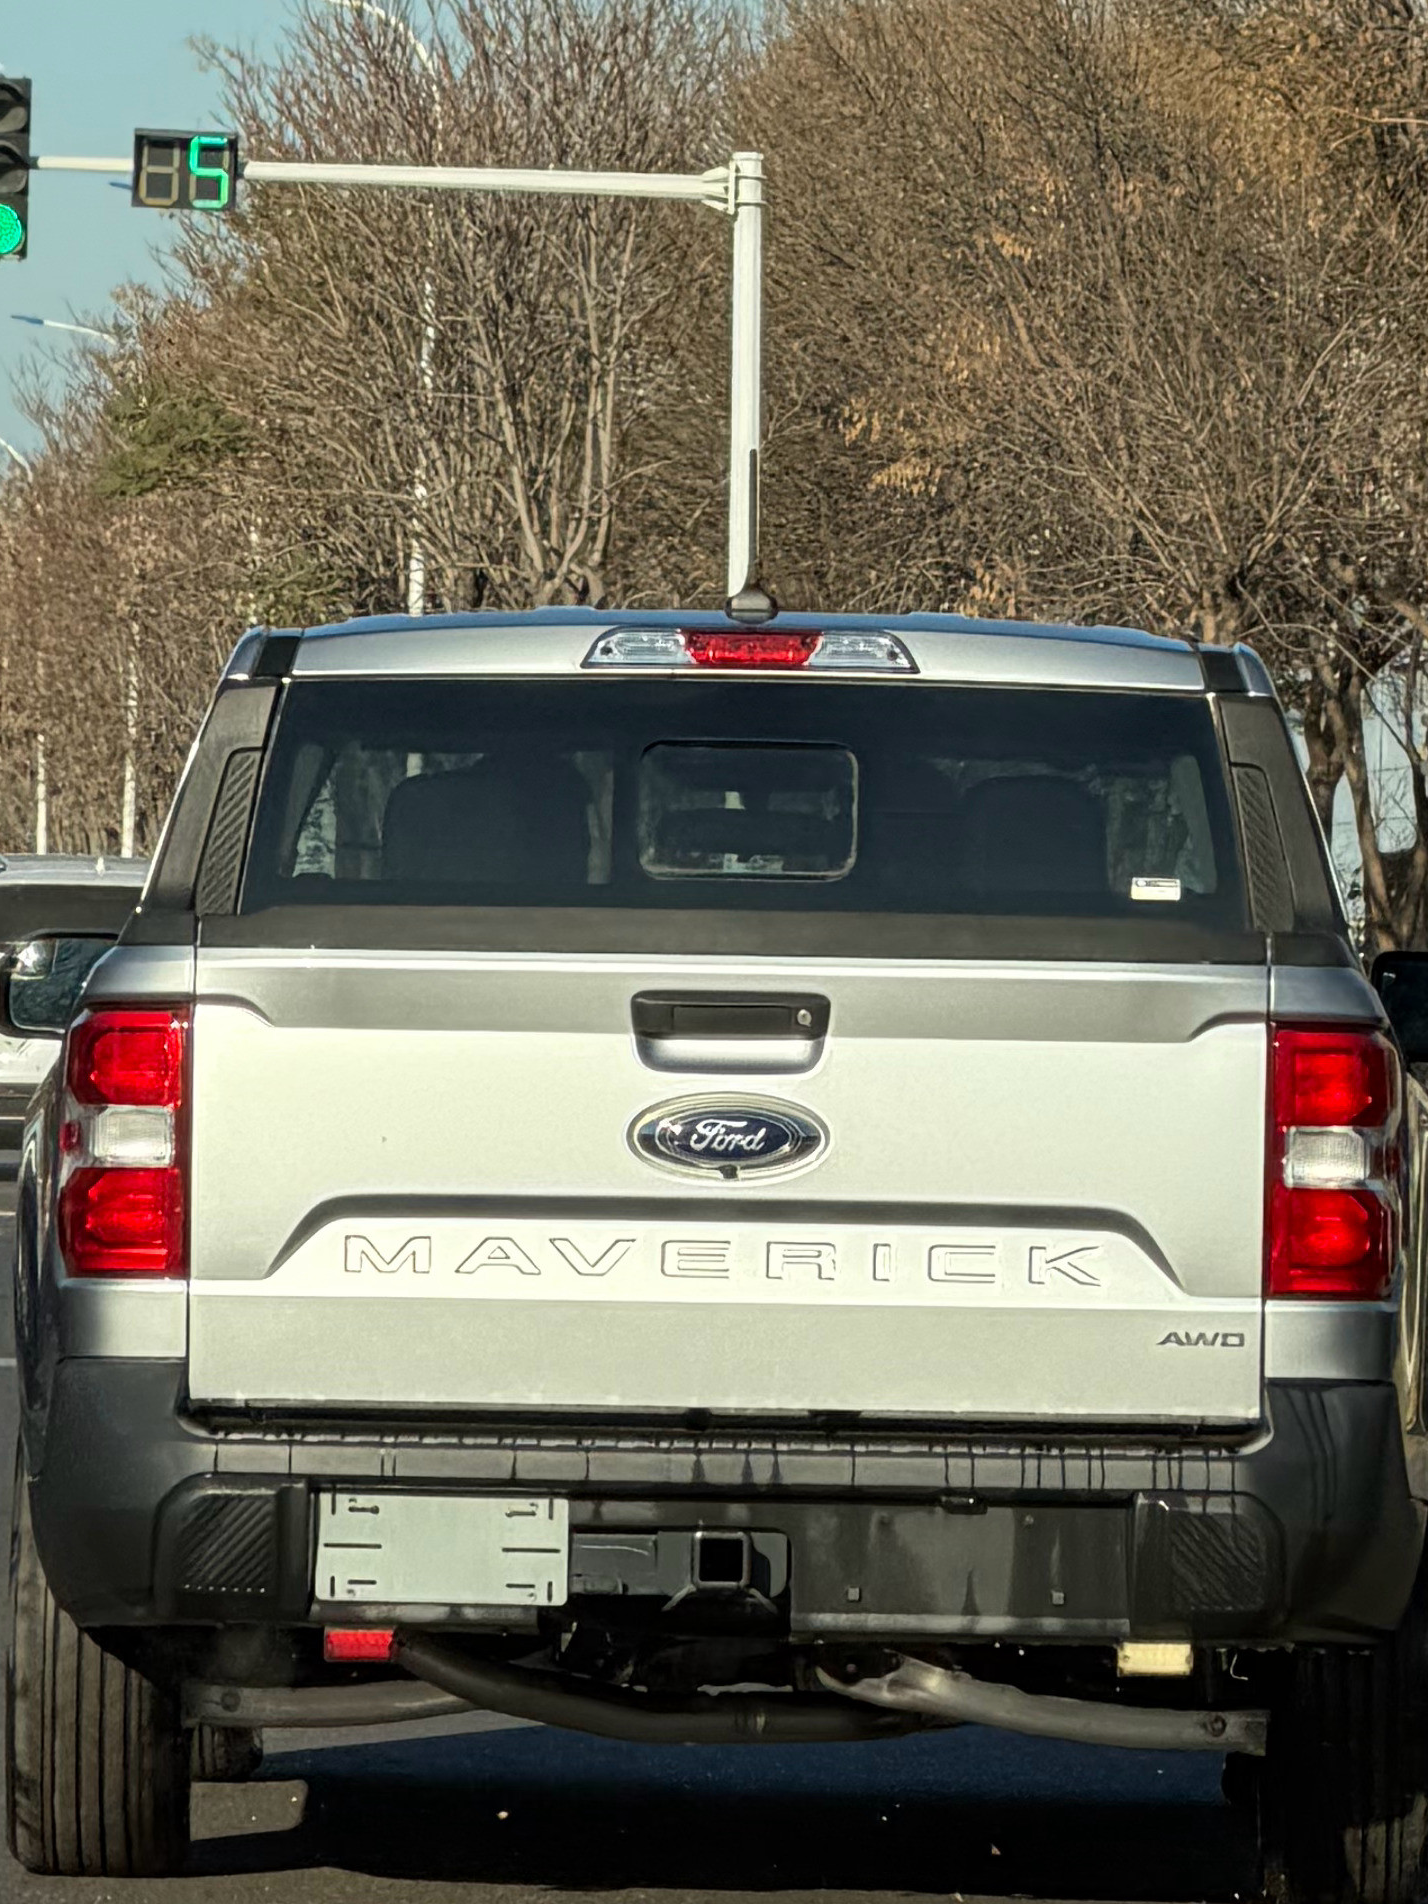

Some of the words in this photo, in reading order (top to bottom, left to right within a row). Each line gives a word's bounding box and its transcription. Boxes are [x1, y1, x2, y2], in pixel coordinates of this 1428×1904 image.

[189, 136, 229, 208] 5
[690, 1119, 767, 1151] Ford
[343, 1234, 1103, 1288] MAVERICK
[1156, 1331, 1245, 1348] AWD
